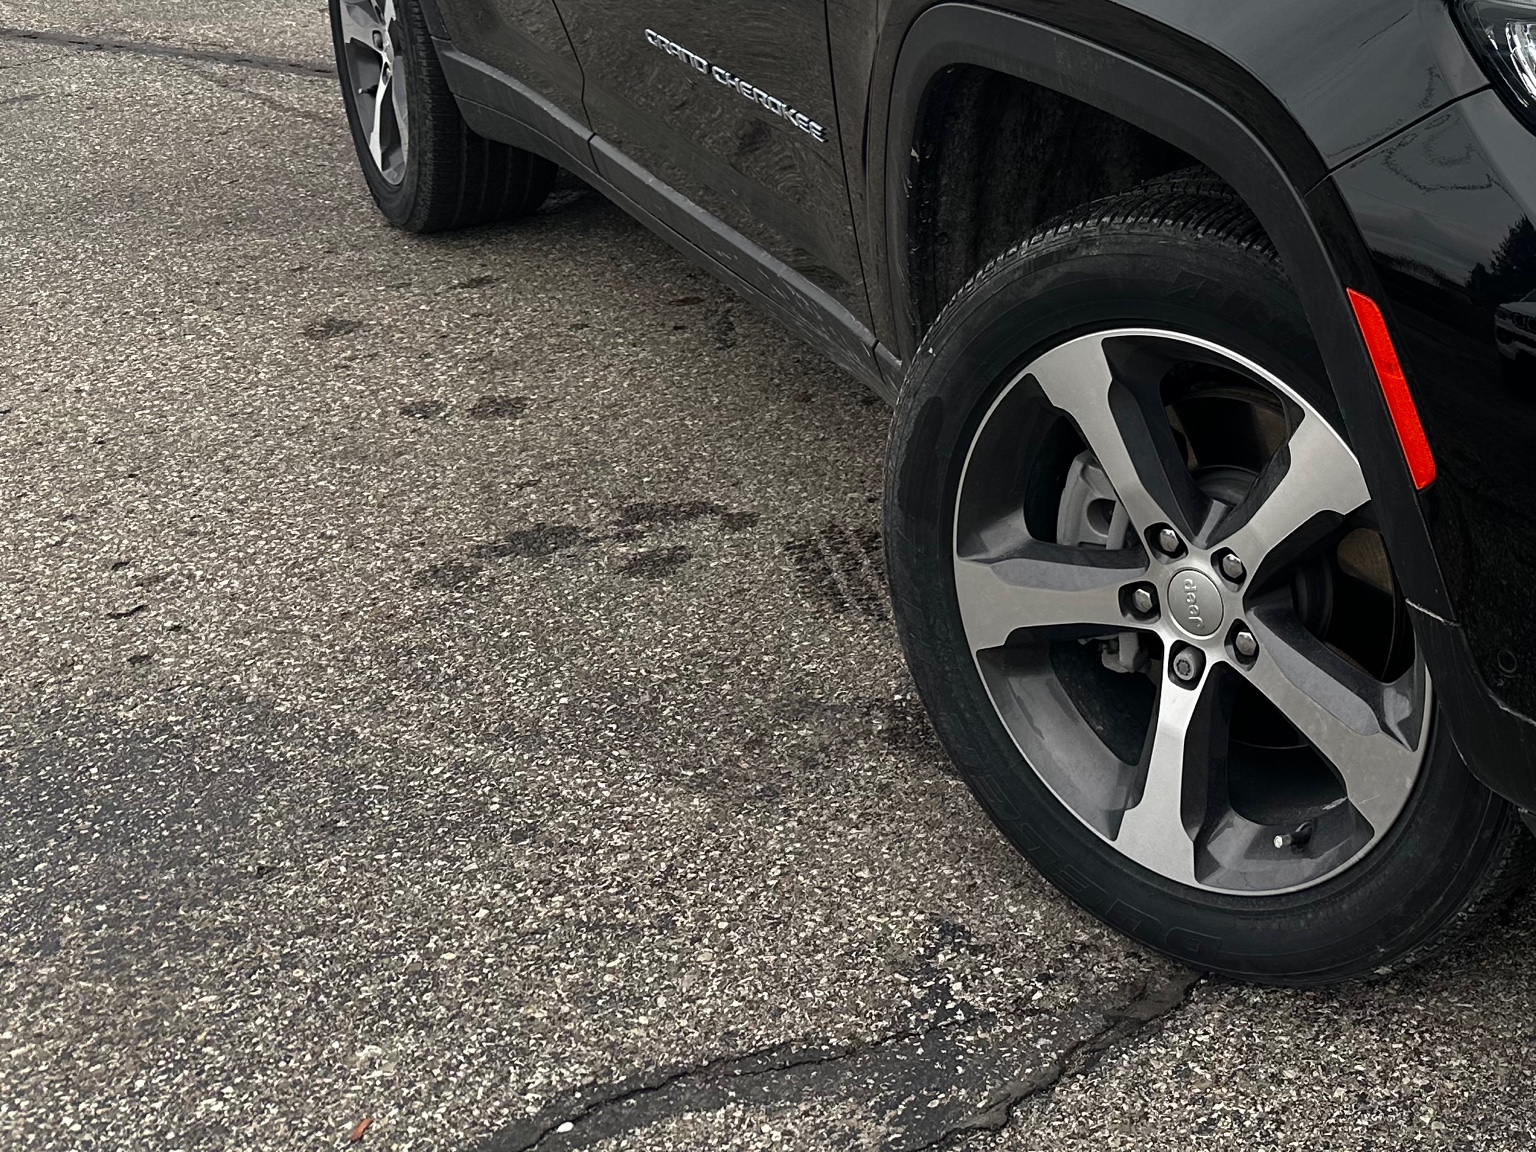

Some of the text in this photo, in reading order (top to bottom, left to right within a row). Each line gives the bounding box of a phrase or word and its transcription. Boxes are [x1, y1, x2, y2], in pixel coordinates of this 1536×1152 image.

[644, 29, 709, 75] GRAND
[711, 66, 828, 143] CHEROKEE
[1183, 578, 1205, 630] Jeep
